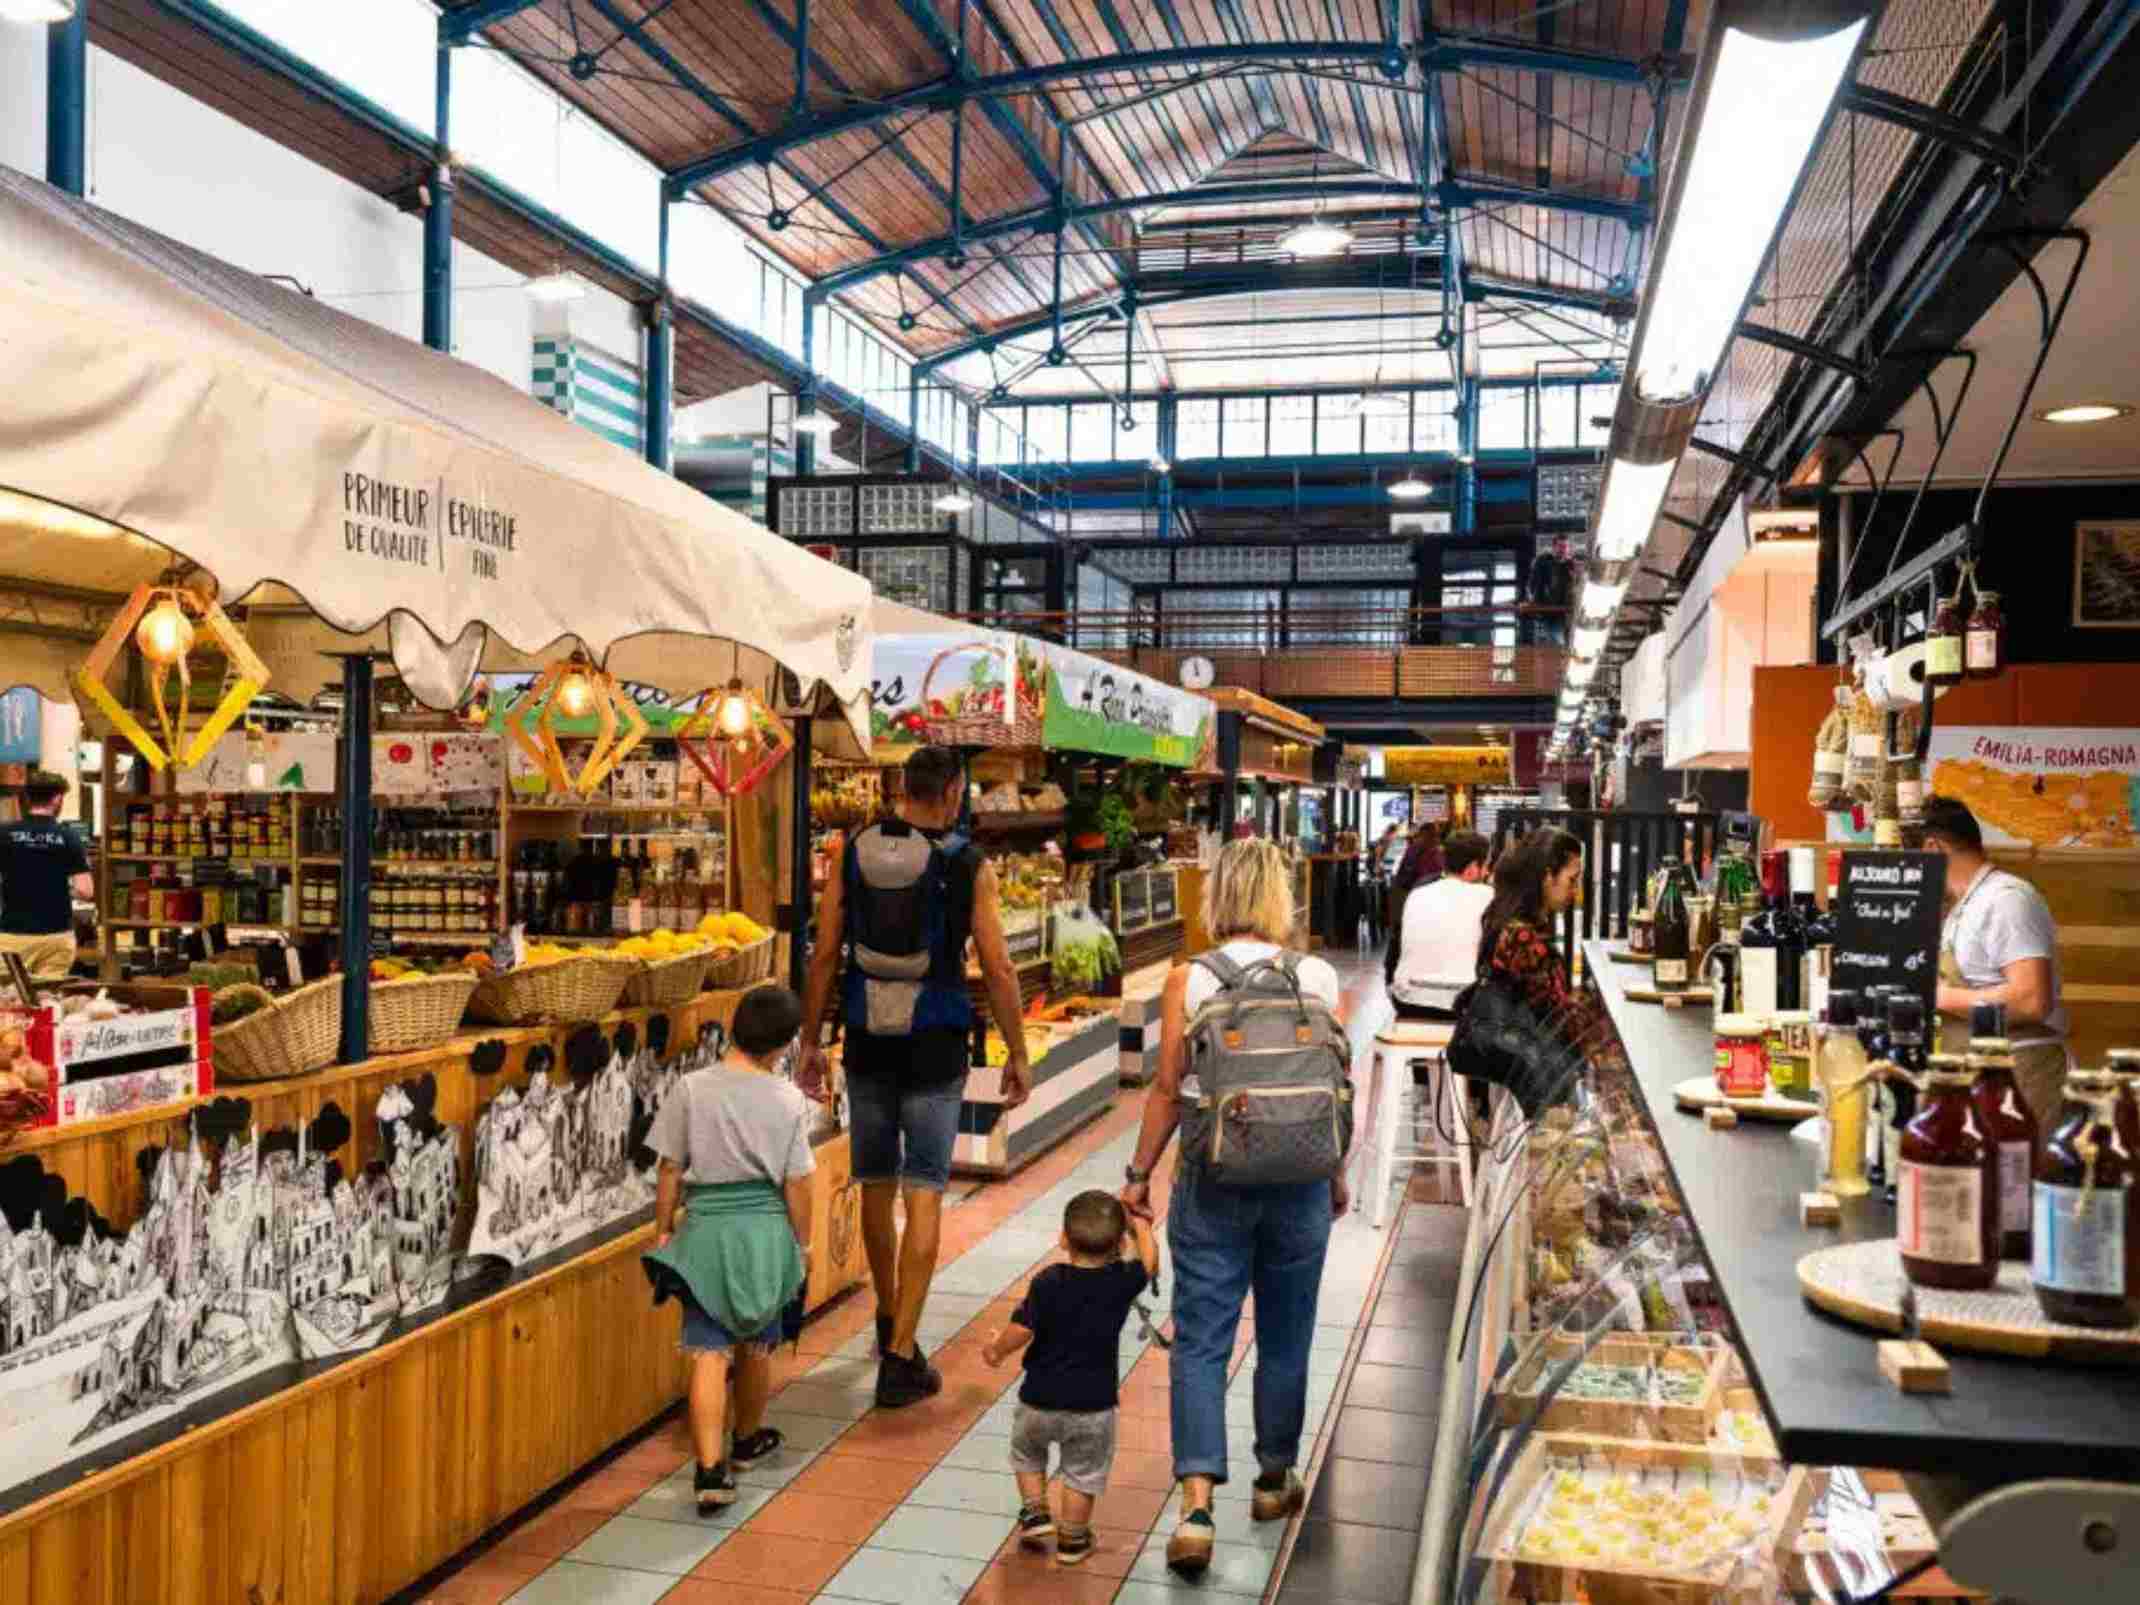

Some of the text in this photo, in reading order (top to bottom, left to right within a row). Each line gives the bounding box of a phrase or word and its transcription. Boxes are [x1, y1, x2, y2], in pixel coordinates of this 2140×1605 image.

[344, 471, 430, 530] PRIMEUR
[448, 498, 517, 552] EPICERIE
[344, 519, 365, 553] DE
